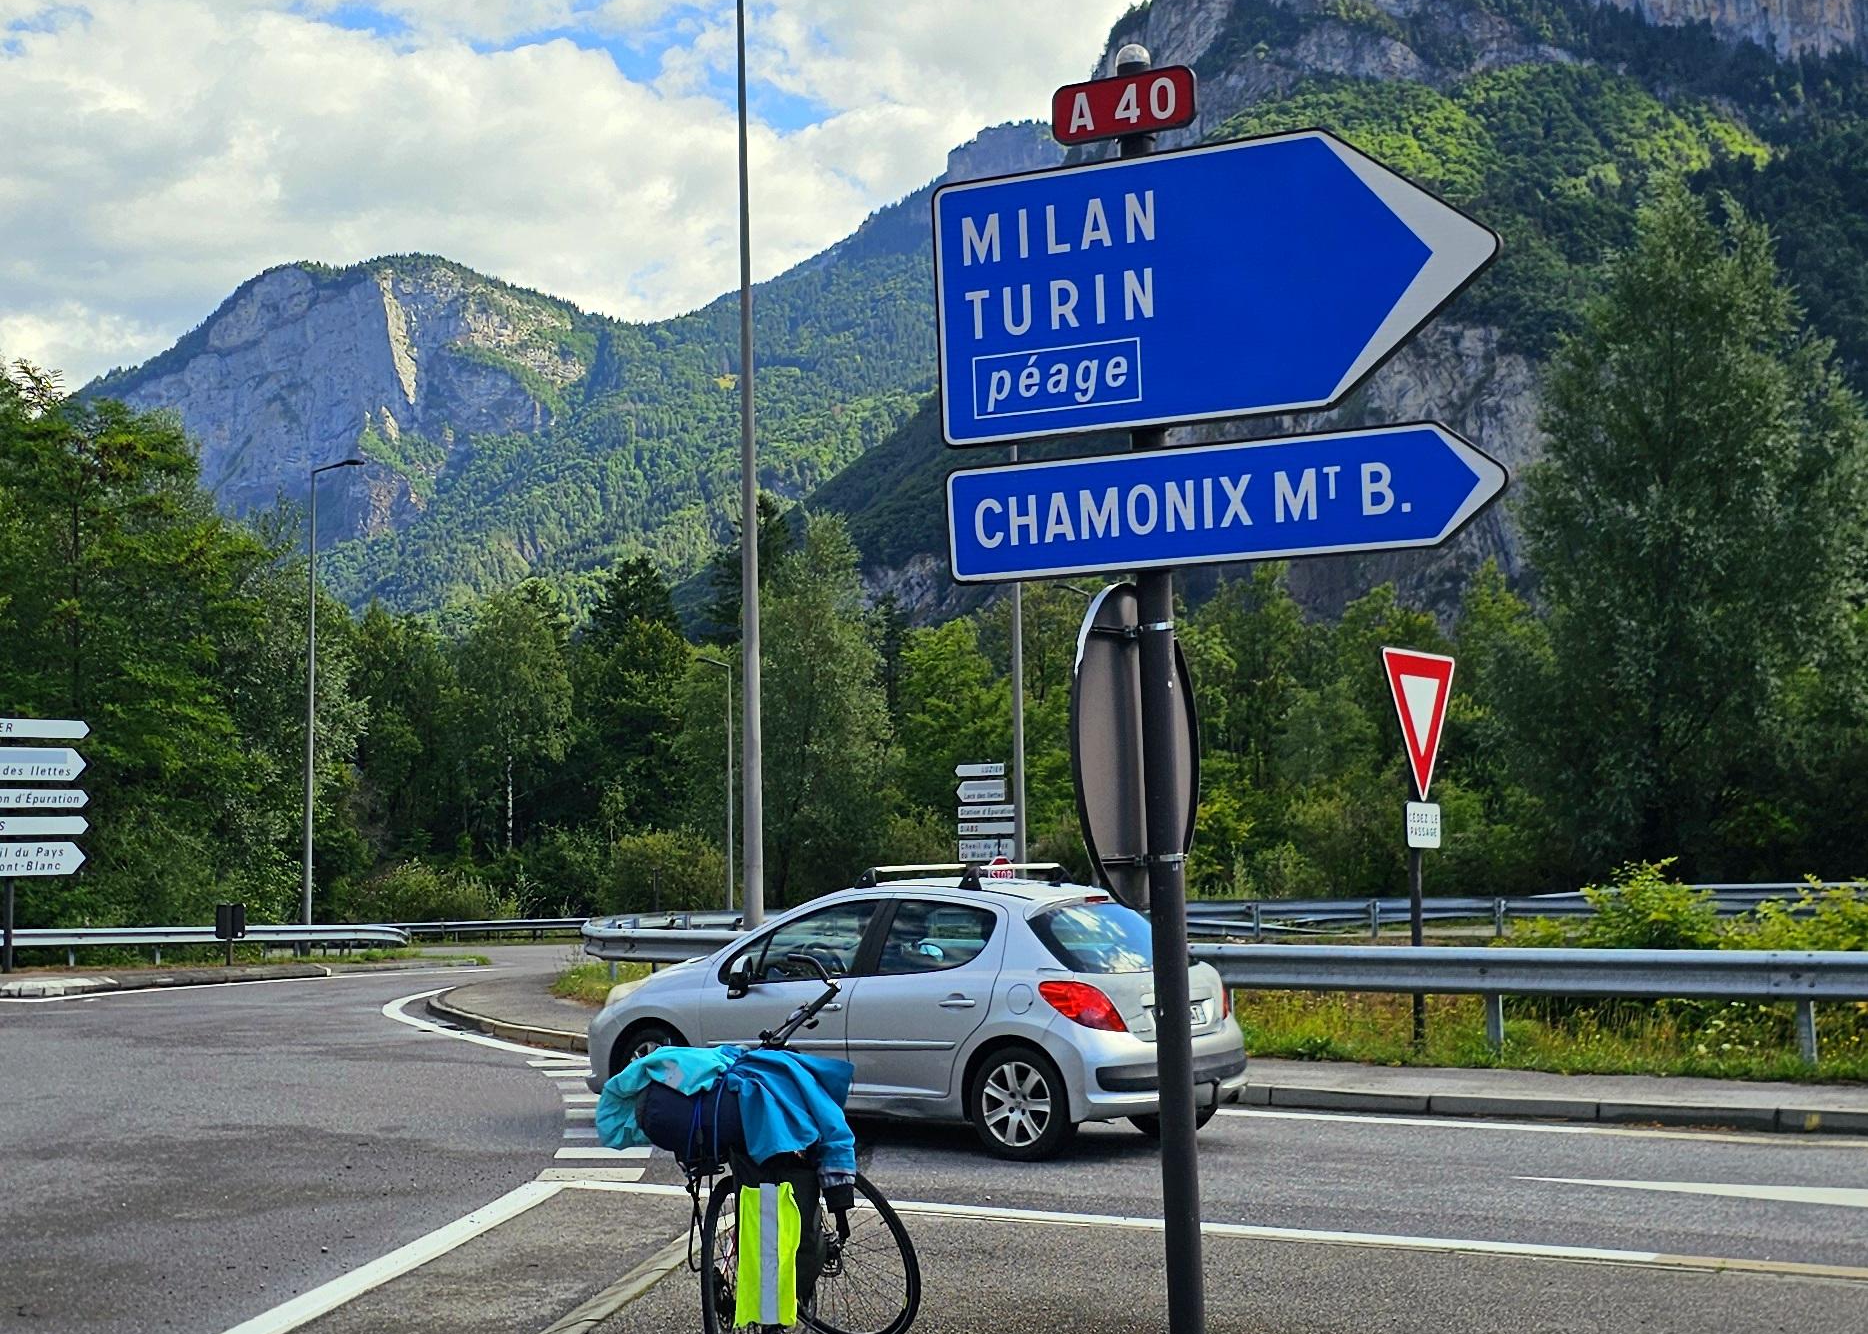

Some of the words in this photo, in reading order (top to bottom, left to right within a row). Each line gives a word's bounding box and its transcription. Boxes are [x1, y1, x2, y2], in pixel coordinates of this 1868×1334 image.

[1068, 92, 1095, 134] A
[1113, 77, 1177, 124] 40
[960, 189, 1156, 267] MILAN
[964, 267, 1155, 341] TURIN
[986, 353, 1129, 413] péage
[973, 473, 1254, 550] CHAMONIX
[1360, 461, 1412, 517] B.
[3, 765, 23, 776] des
[15, 791, 80, 806] d'Épuration
[1410, 826, 1437, 837] PASSAGE
[15, 847, 29, 858] du
[36, 846, 64, 859] Pays
[991, 870, 1012, 878] STOP
